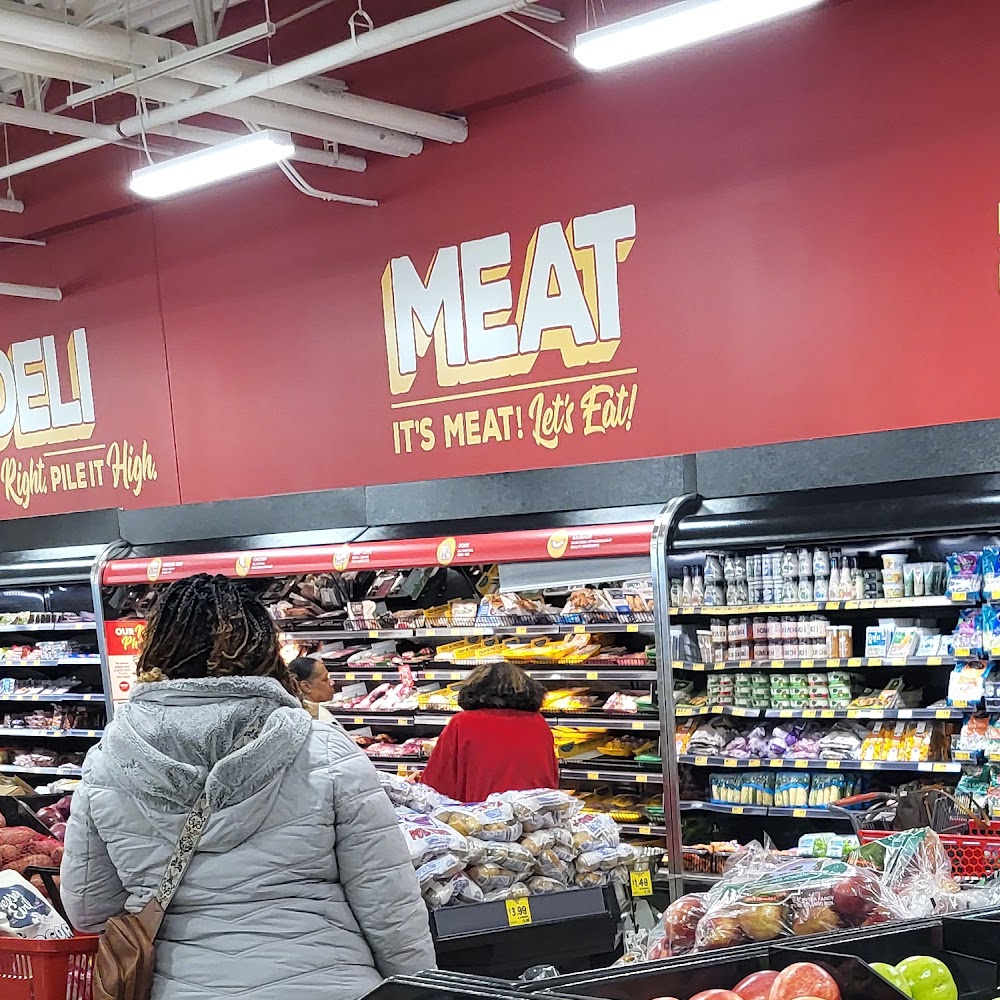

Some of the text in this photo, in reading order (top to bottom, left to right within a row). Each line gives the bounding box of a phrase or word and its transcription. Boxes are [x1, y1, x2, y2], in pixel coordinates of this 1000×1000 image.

[382, 204, 636, 395] MEAT
[393, 382, 639, 454] IT'S MEAT! Let's Eat!
[1, 440, 158, 510] Right. PILE IT High.
